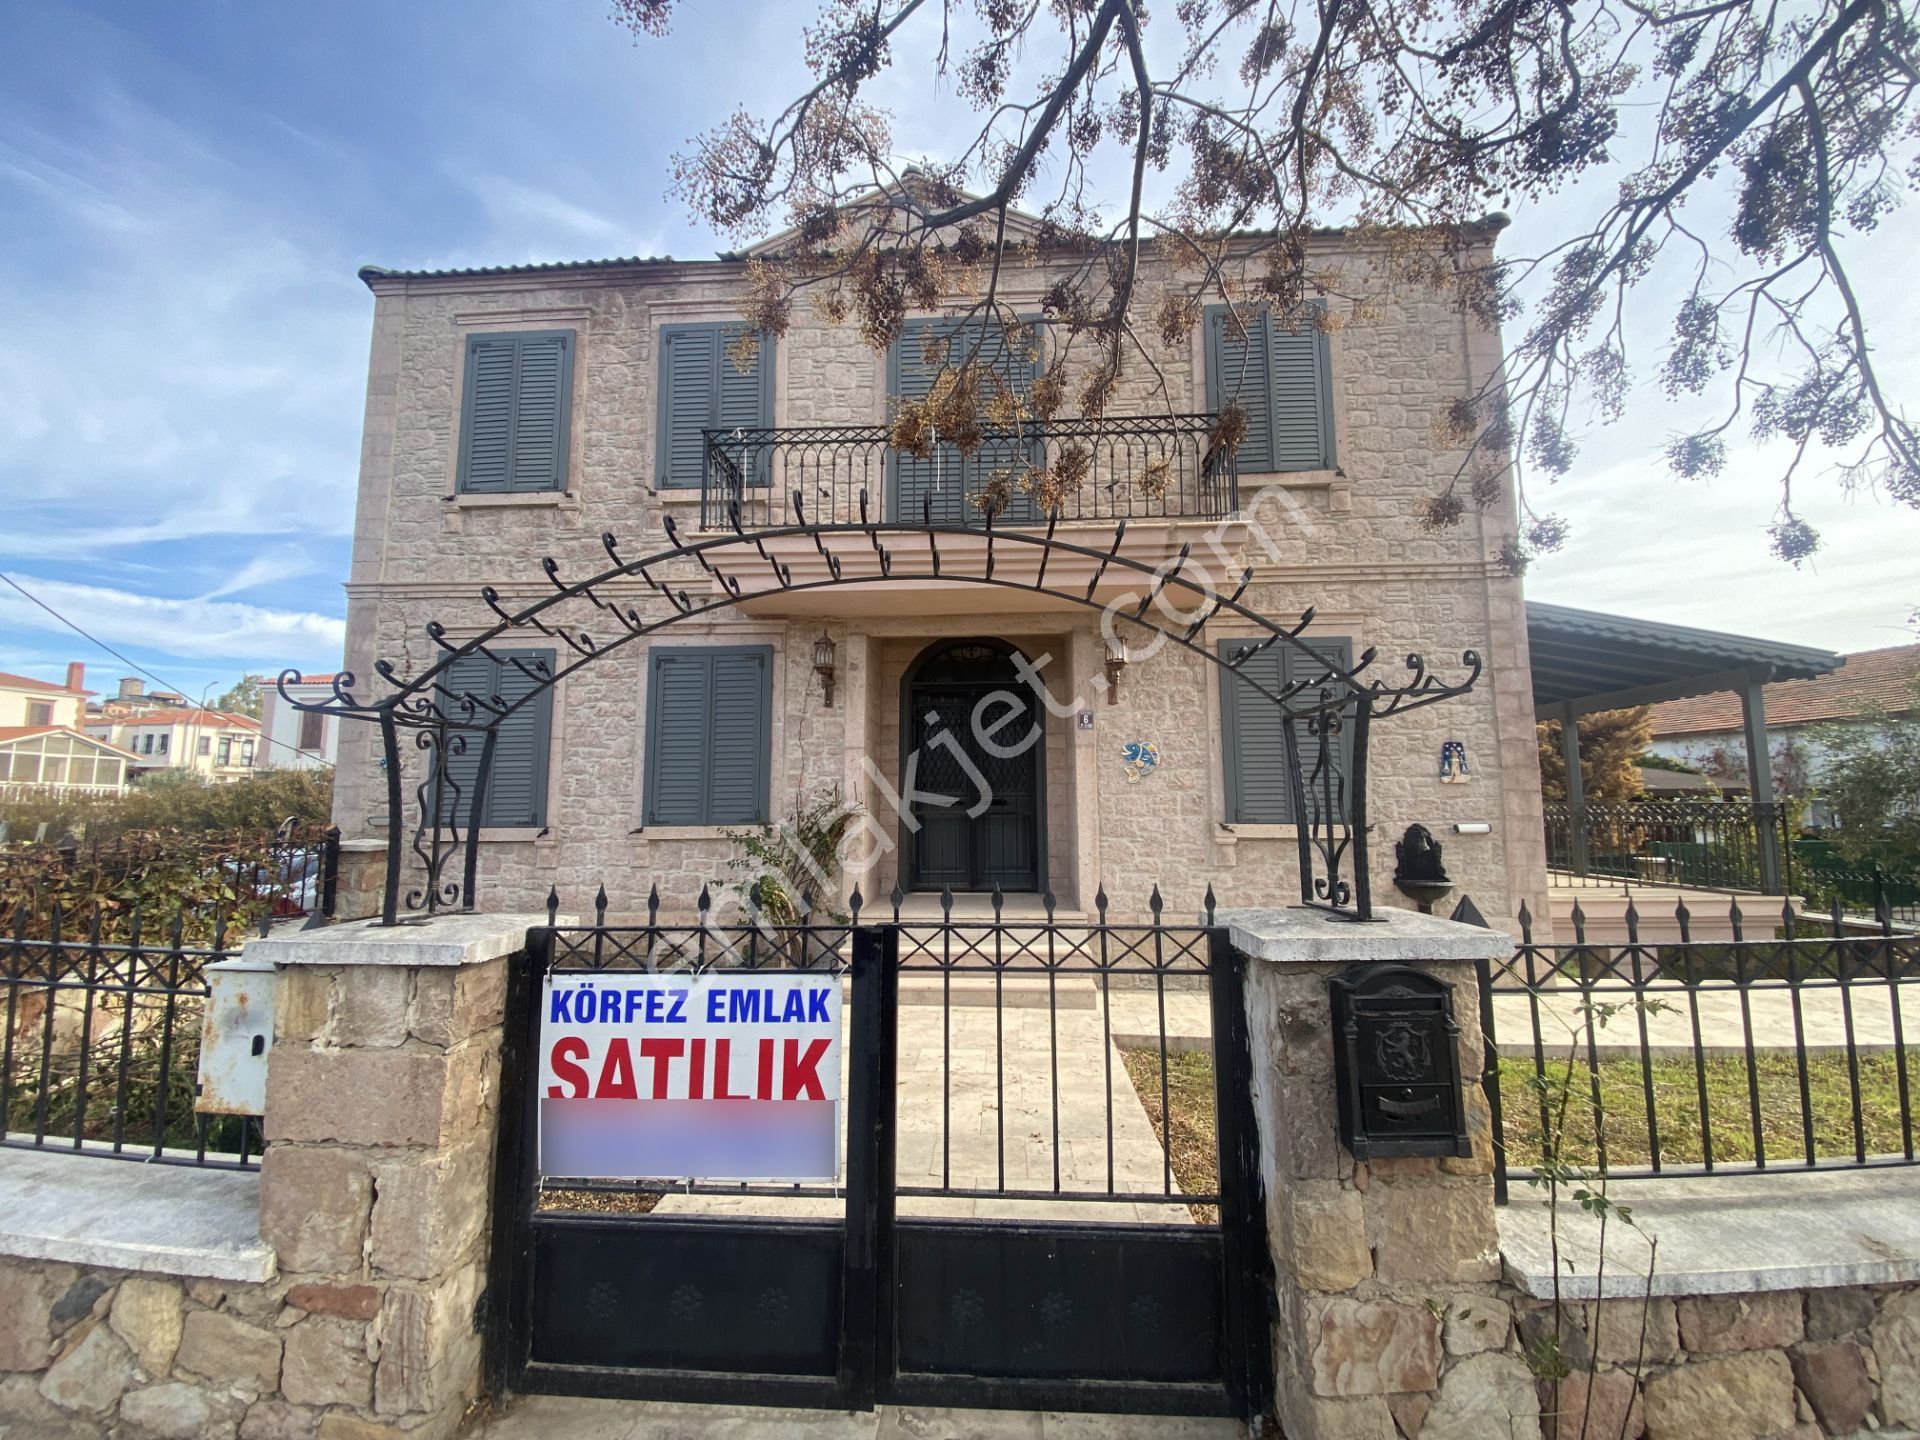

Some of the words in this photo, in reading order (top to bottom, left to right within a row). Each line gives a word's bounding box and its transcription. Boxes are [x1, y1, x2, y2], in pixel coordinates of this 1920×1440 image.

[551, 983, 688, 1024] KÖRFEZ
[706, 988, 832, 1023] EMLAK
[547, 1036, 833, 1101] SATILIK
